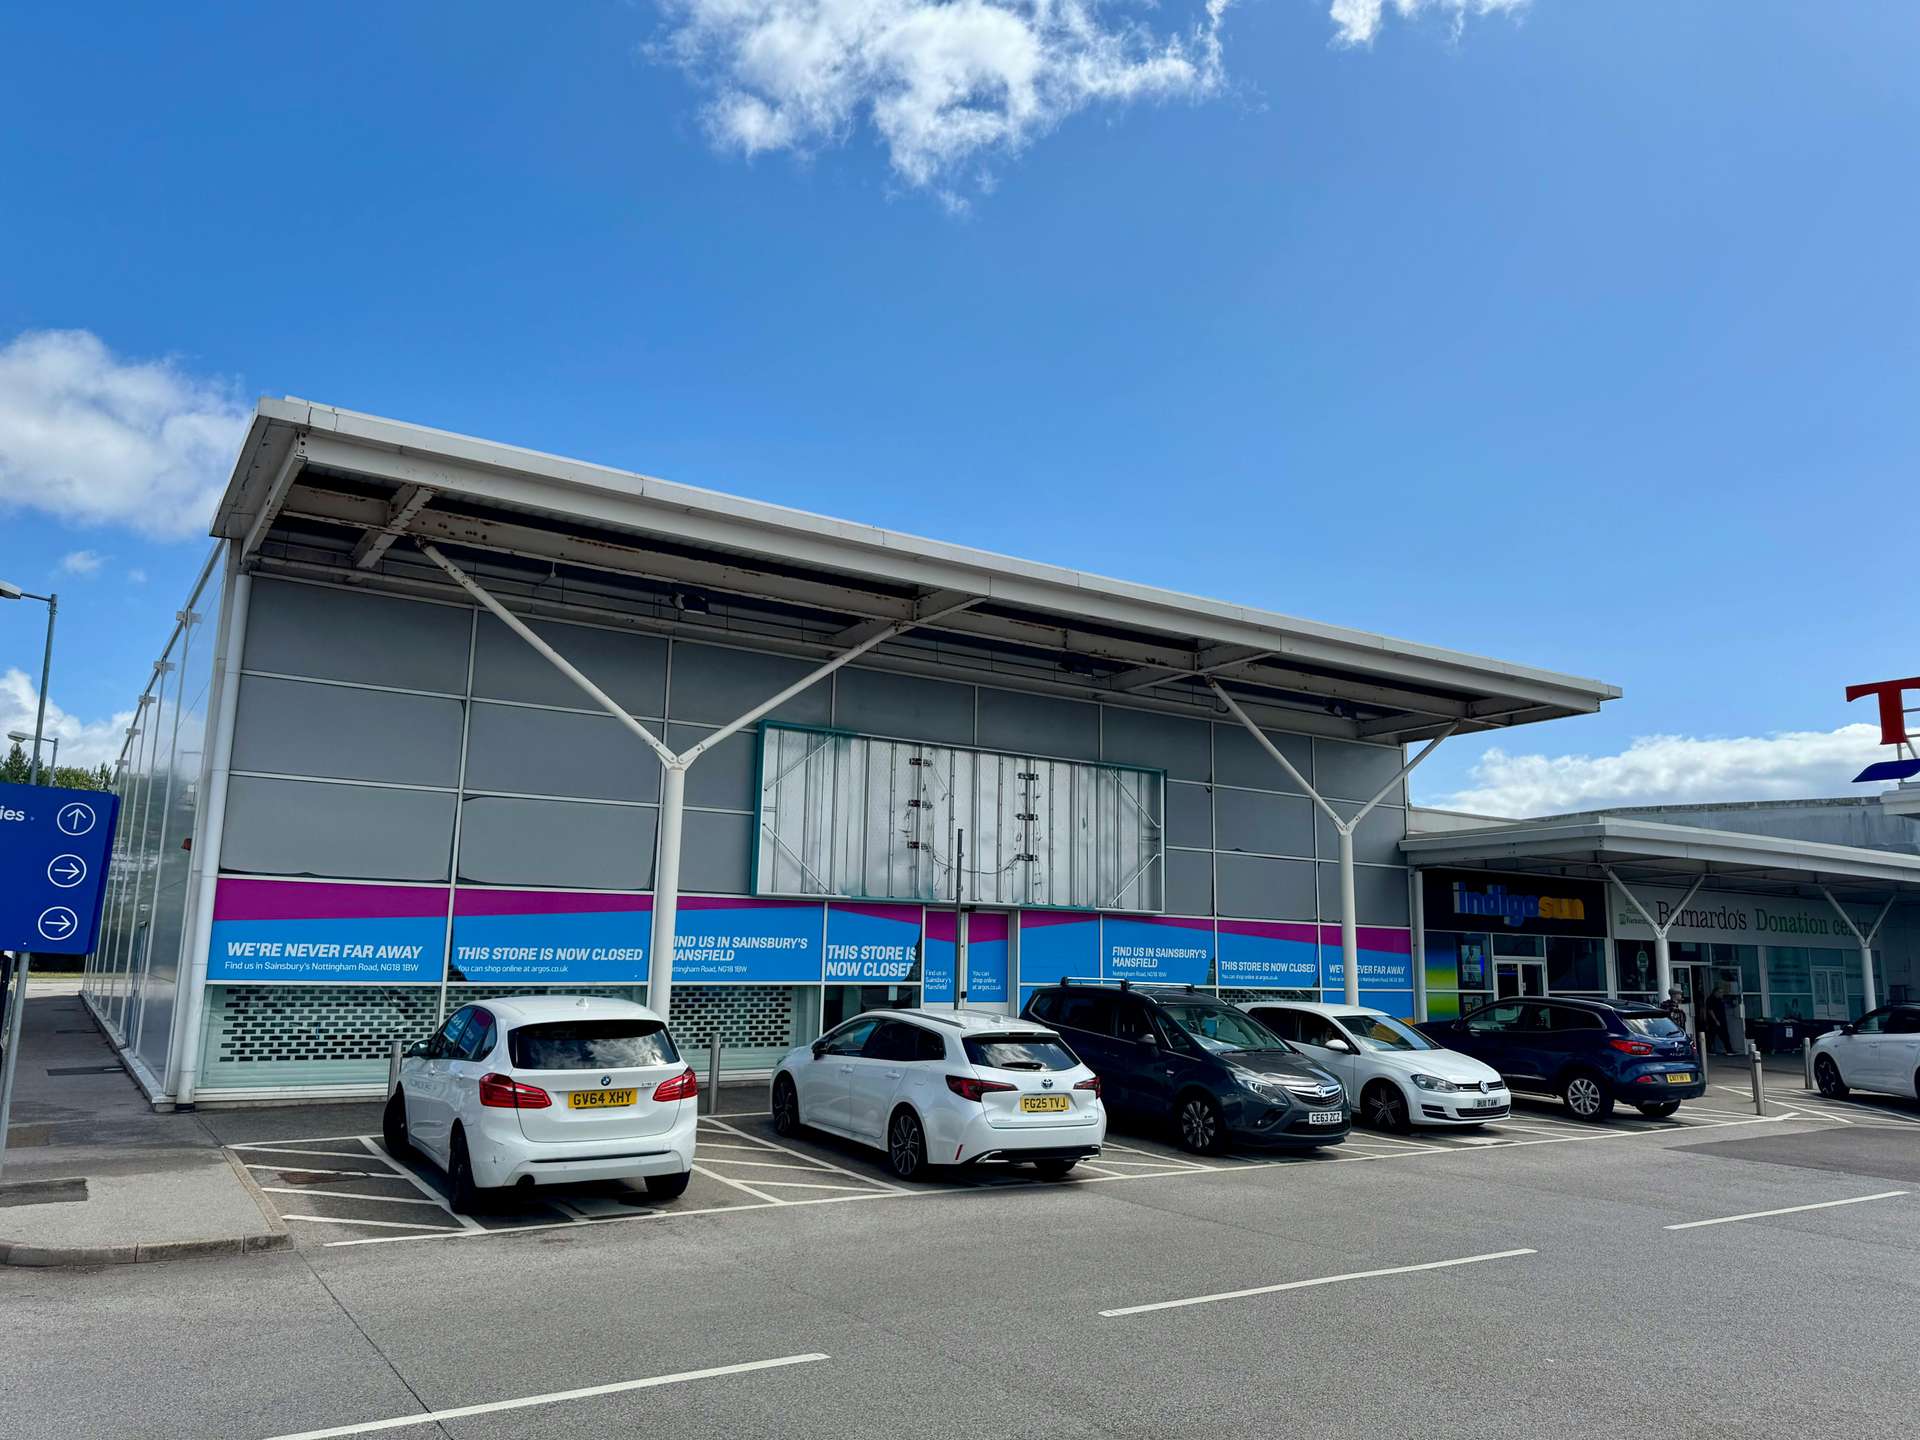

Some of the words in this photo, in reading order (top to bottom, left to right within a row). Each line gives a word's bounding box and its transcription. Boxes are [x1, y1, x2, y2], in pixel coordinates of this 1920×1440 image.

[1754, 908, 1829, 936] Donation
[674, 935, 697, 948] IND
[698, 935, 715, 948] US
[716, 936, 730, 948] IN
[732, 936, 808, 949] SAINSBURY'S
[227, 941, 283, 957] WE'RE
[284, 943, 340, 958] NEVER
[342, 944, 375, 958] FAR
[375, 945, 424, 959] AWAY
[457, 947, 490, 960] THIS
[492, 947, 538, 960] STORE
[539, 948, 554, 960] IS
[555, 948, 591, 961] NOW
[592, 948, 643, 961] CLOSED
[673, 949, 735, 961] ANSFIELD
[827, 944, 858, 960] THIS
[860, 945, 903, 960] STORE
[905, 946, 917, 961] IS
[1112, 946, 1132, 957] FIND
[1133, 947, 1145, 957] US
[1145, 947, 1155, 957] IN
[1155, 948, 1207, 960] SAINSBURY'S
[225, 961, 243, 970] Find
[255, 962, 263, 970] in
[264, 962, 311, 972] Sainsbury's
[312, 962, 357, 973] Nottingham
[358, 963, 380, 973] Road,
[380, 963, 401, 972] NG18
[1112, 957, 1158, 968] MANSFIELD
[1221, 960, 1238, 971] THIS
[1238, 961, 1262, 971] STORE
[1262, 962, 1270, 972] IS
[1270, 962, 1288, 972] NOW
[1289, 963, 1316, 973] CLOSED
[484, 965, 501, 974] shop
[531, 965, 568, 974] argos.co.uk
[672, 965, 700, 974] ttingham
[825, 962, 862, 977] NOW
[1328, 964, 1344, 974] WE'
[1356, 965, 1374, 975] EVER
[1373, 965, 1387, 975] FAR
[1386, 965, 1405, 975] AWAY
[573, 1092, 605, 1106] GV64
[609, 1090, 632, 1104] XHY
[1024, 1098, 1047, 1109] FG25
[1311, 1113, 1329, 1122] CE63
